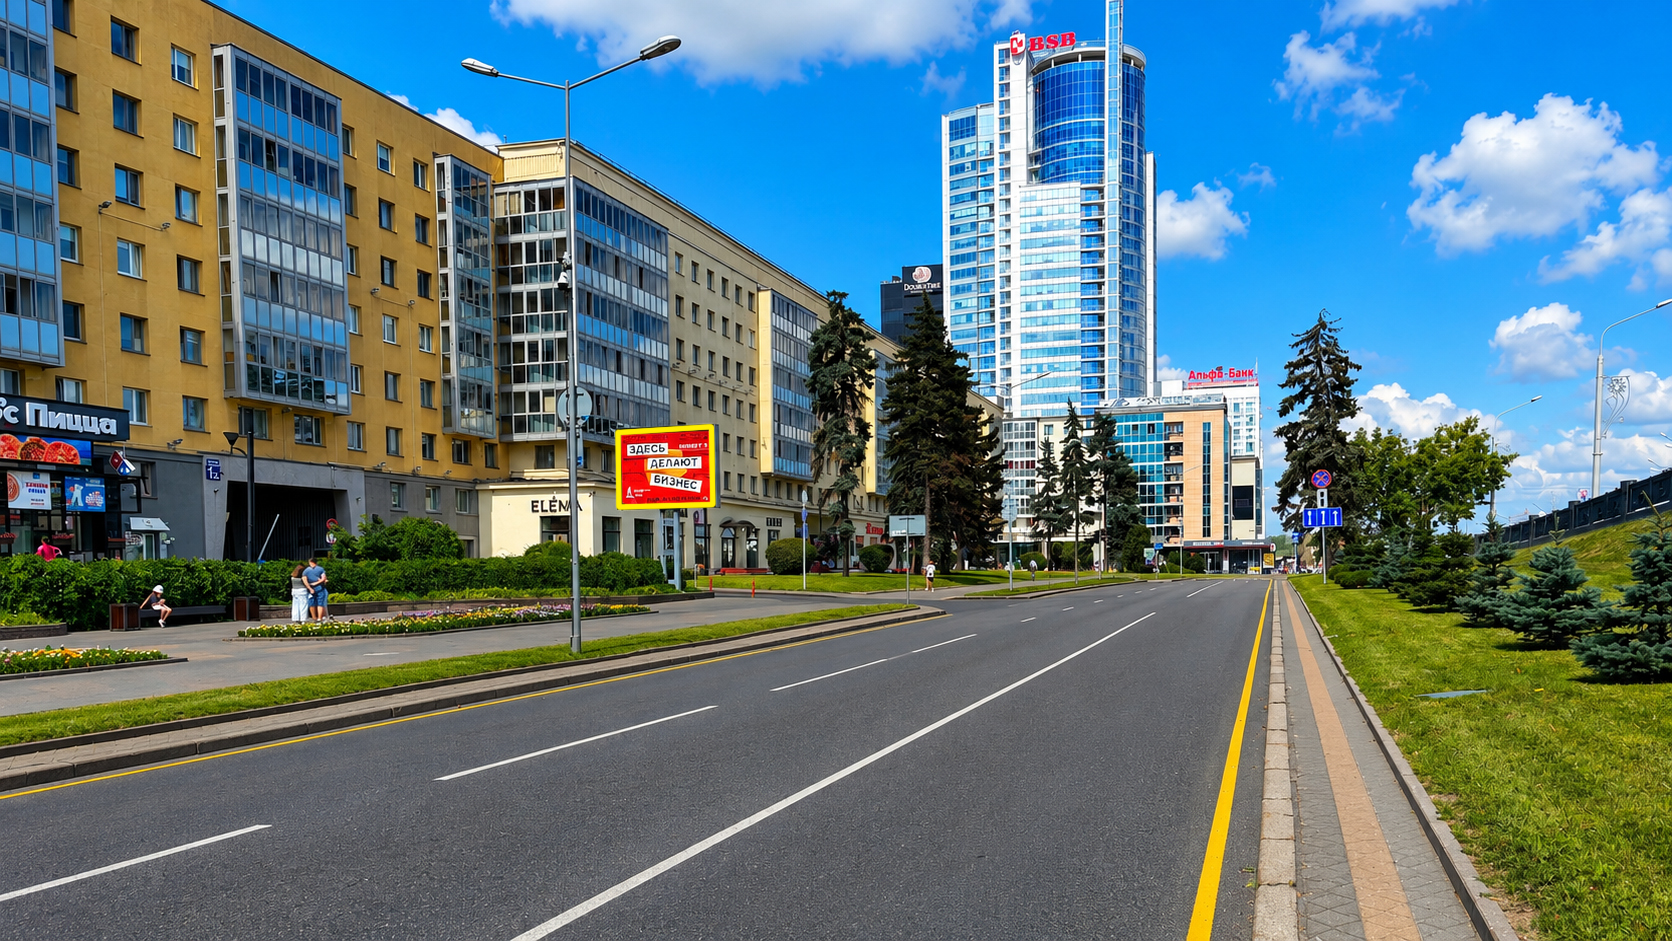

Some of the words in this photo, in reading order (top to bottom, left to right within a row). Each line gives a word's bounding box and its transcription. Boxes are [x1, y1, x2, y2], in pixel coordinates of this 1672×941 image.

[1028, 31, 1076, 52] BSB
[26, 402, 117, 435] Пицца
[629, 444, 666, 455] ЗДЕСЬ
[650, 457, 698, 470] ДЕЛАЮТ
[653, 474, 698, 490] БИЗНЕС
